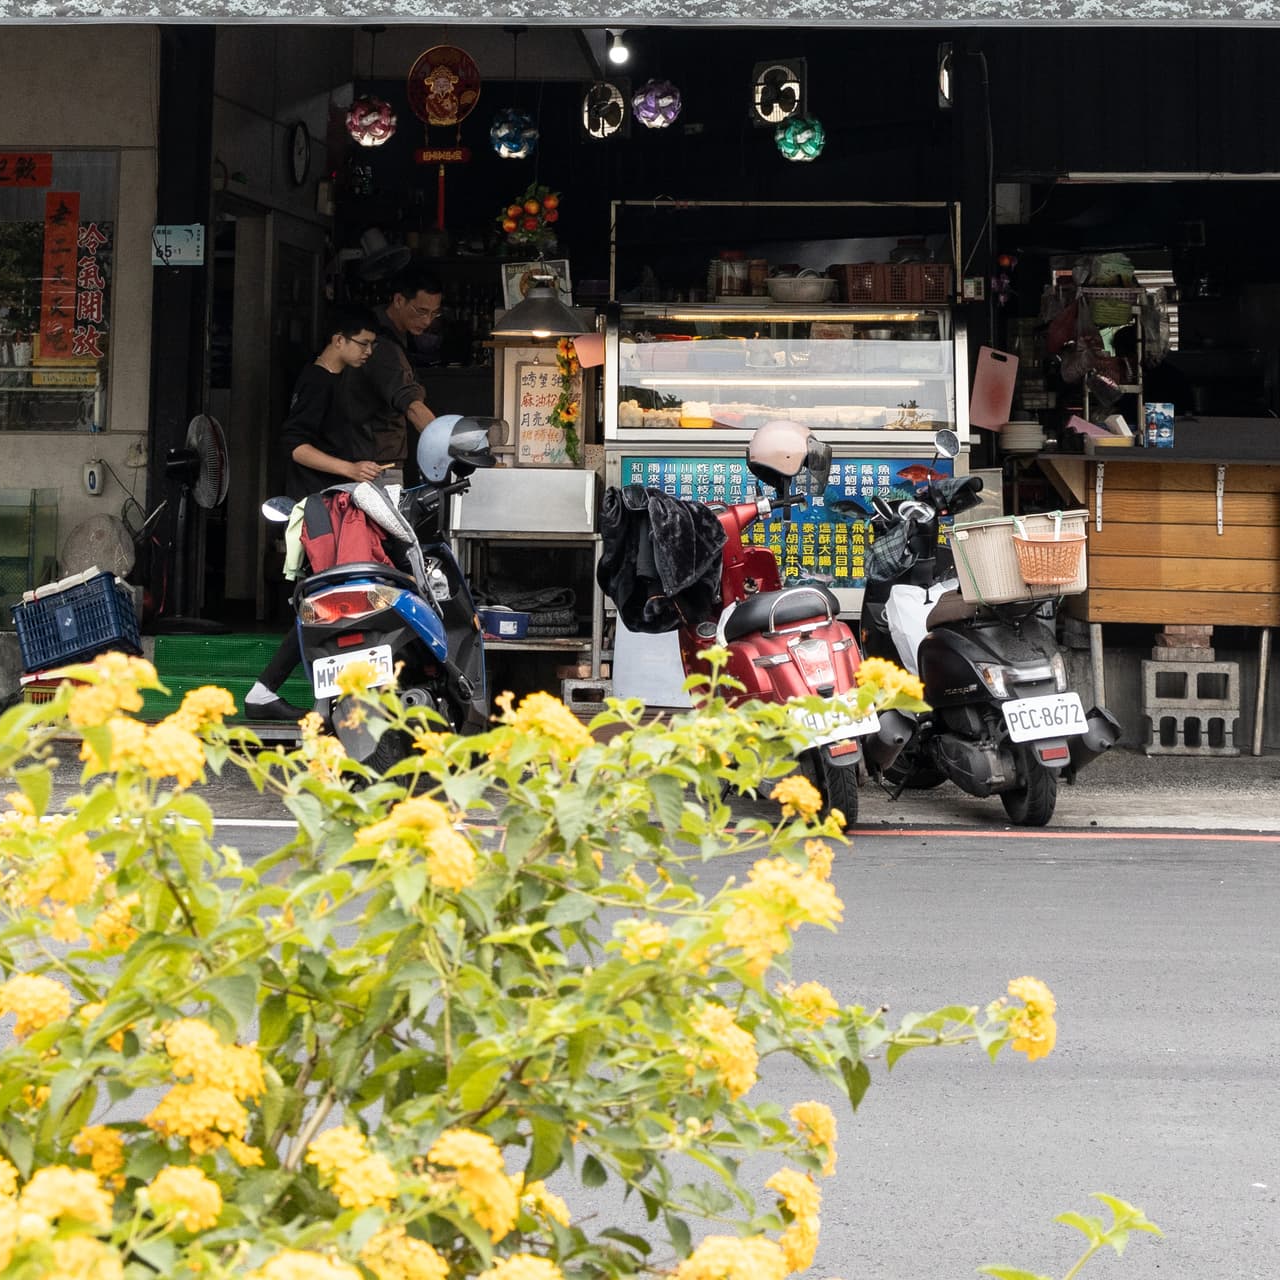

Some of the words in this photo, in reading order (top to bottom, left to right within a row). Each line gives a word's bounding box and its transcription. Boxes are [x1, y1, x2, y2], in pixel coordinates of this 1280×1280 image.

[72, 222, 108, 359] 冷氣開放
[1008, 703, 1084, 732] PCC-8672
